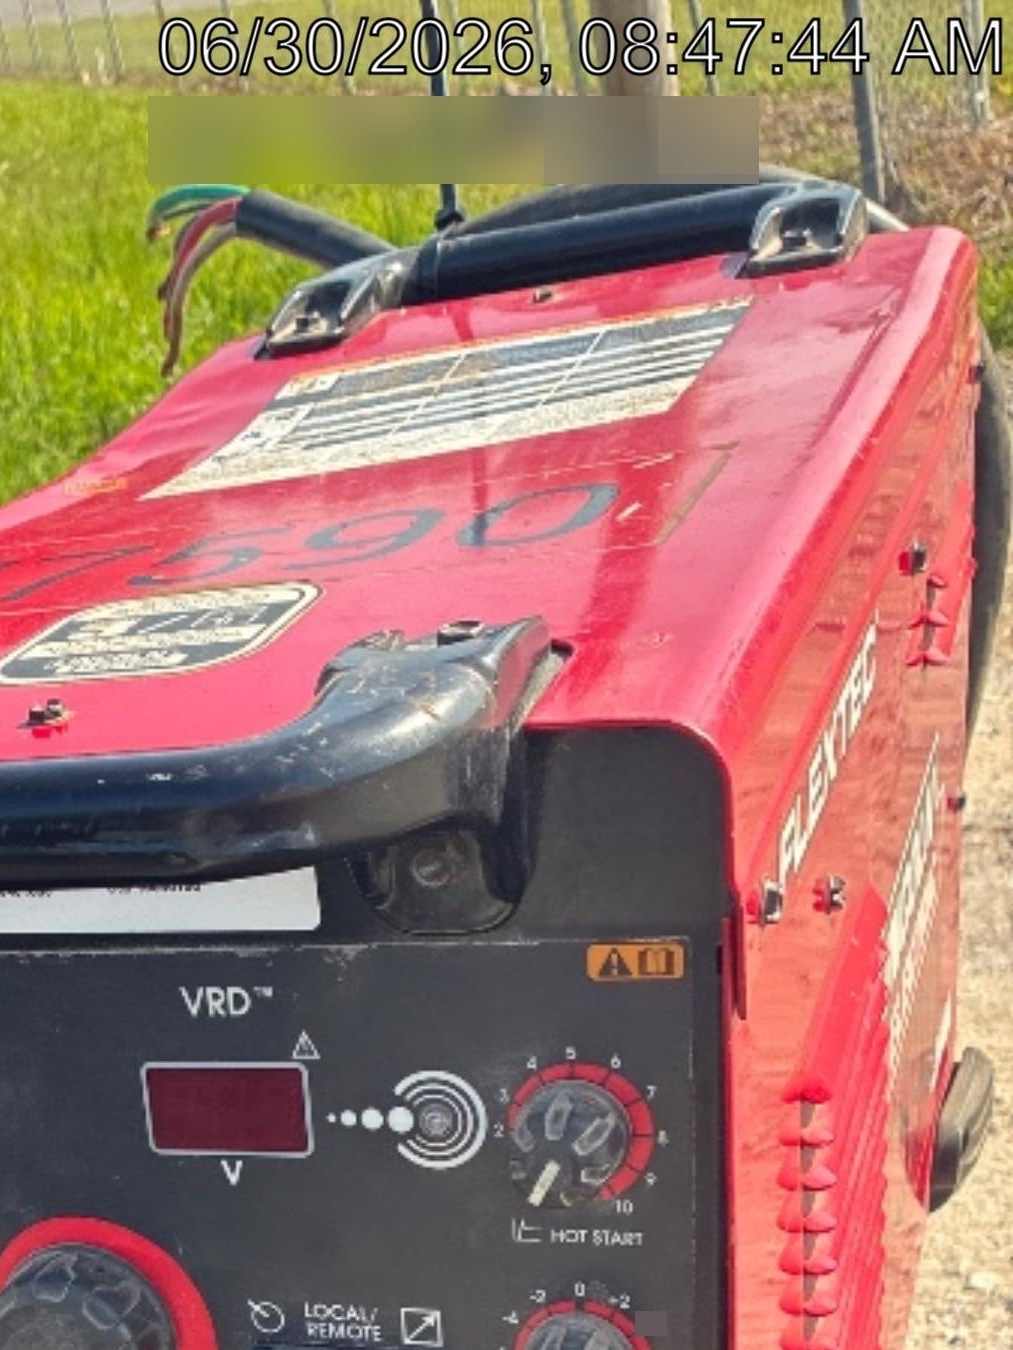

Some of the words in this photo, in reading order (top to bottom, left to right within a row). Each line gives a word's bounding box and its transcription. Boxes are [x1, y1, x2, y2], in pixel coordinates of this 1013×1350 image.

[565, 1046, 576, 1060] 5
[526, 1055, 537, 1069] 4
[610, 1055, 621, 1069] 6
[646, 1085, 657, 1099] 7
[493, 1124, 504, 1138] 2
[221, 1160, 243, 1186] V
[615, 1199, 634, 1214] 10
[550, 1229, 588, 1244] HOT
[592, 1229, 644, 1246] START
[304, 1302, 379, 1321] LOCAL/
[306, 1321, 382, 1342] REMOTE
